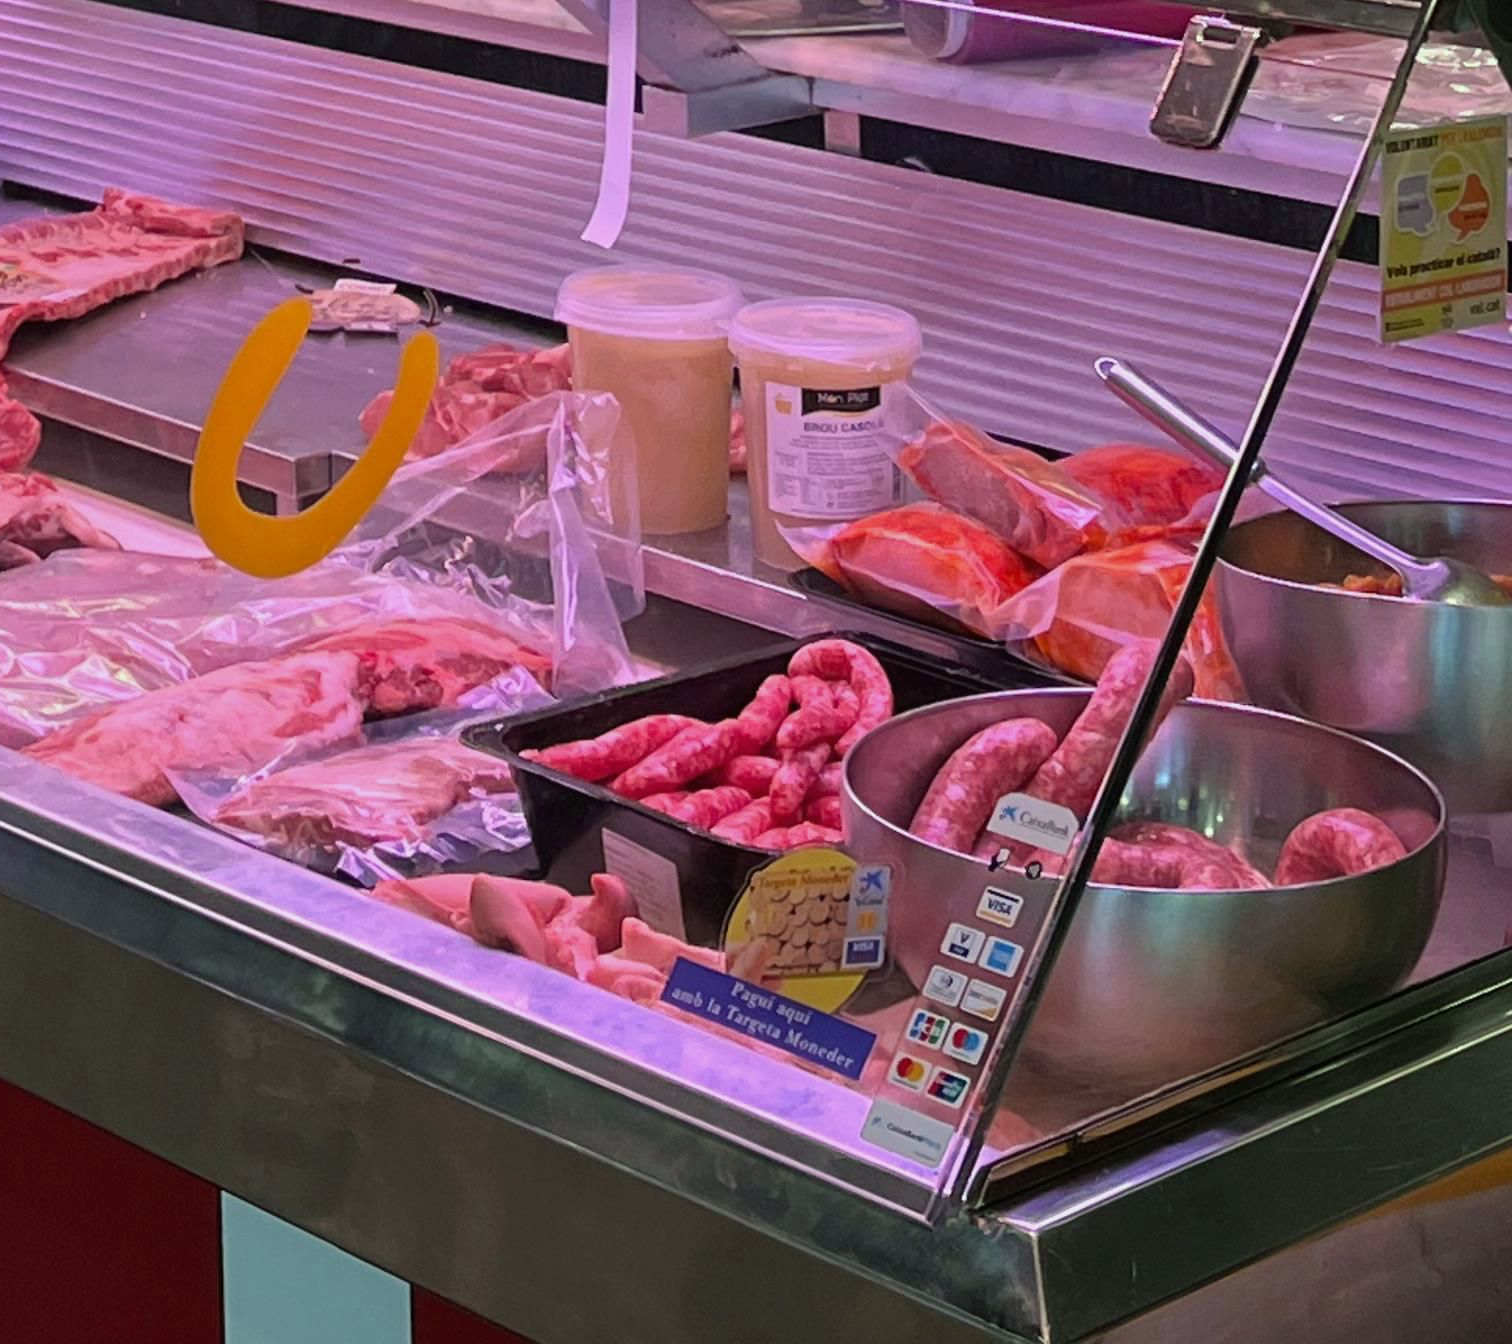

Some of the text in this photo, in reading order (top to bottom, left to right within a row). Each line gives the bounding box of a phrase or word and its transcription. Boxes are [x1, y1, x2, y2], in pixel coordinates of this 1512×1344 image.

[803, 421, 838, 433] BROU
[987, 898, 1014, 916] VISA
[731, 980, 777, 1010] Pagui
[671, 986, 854, 1069] amb la Targeta Moneder
